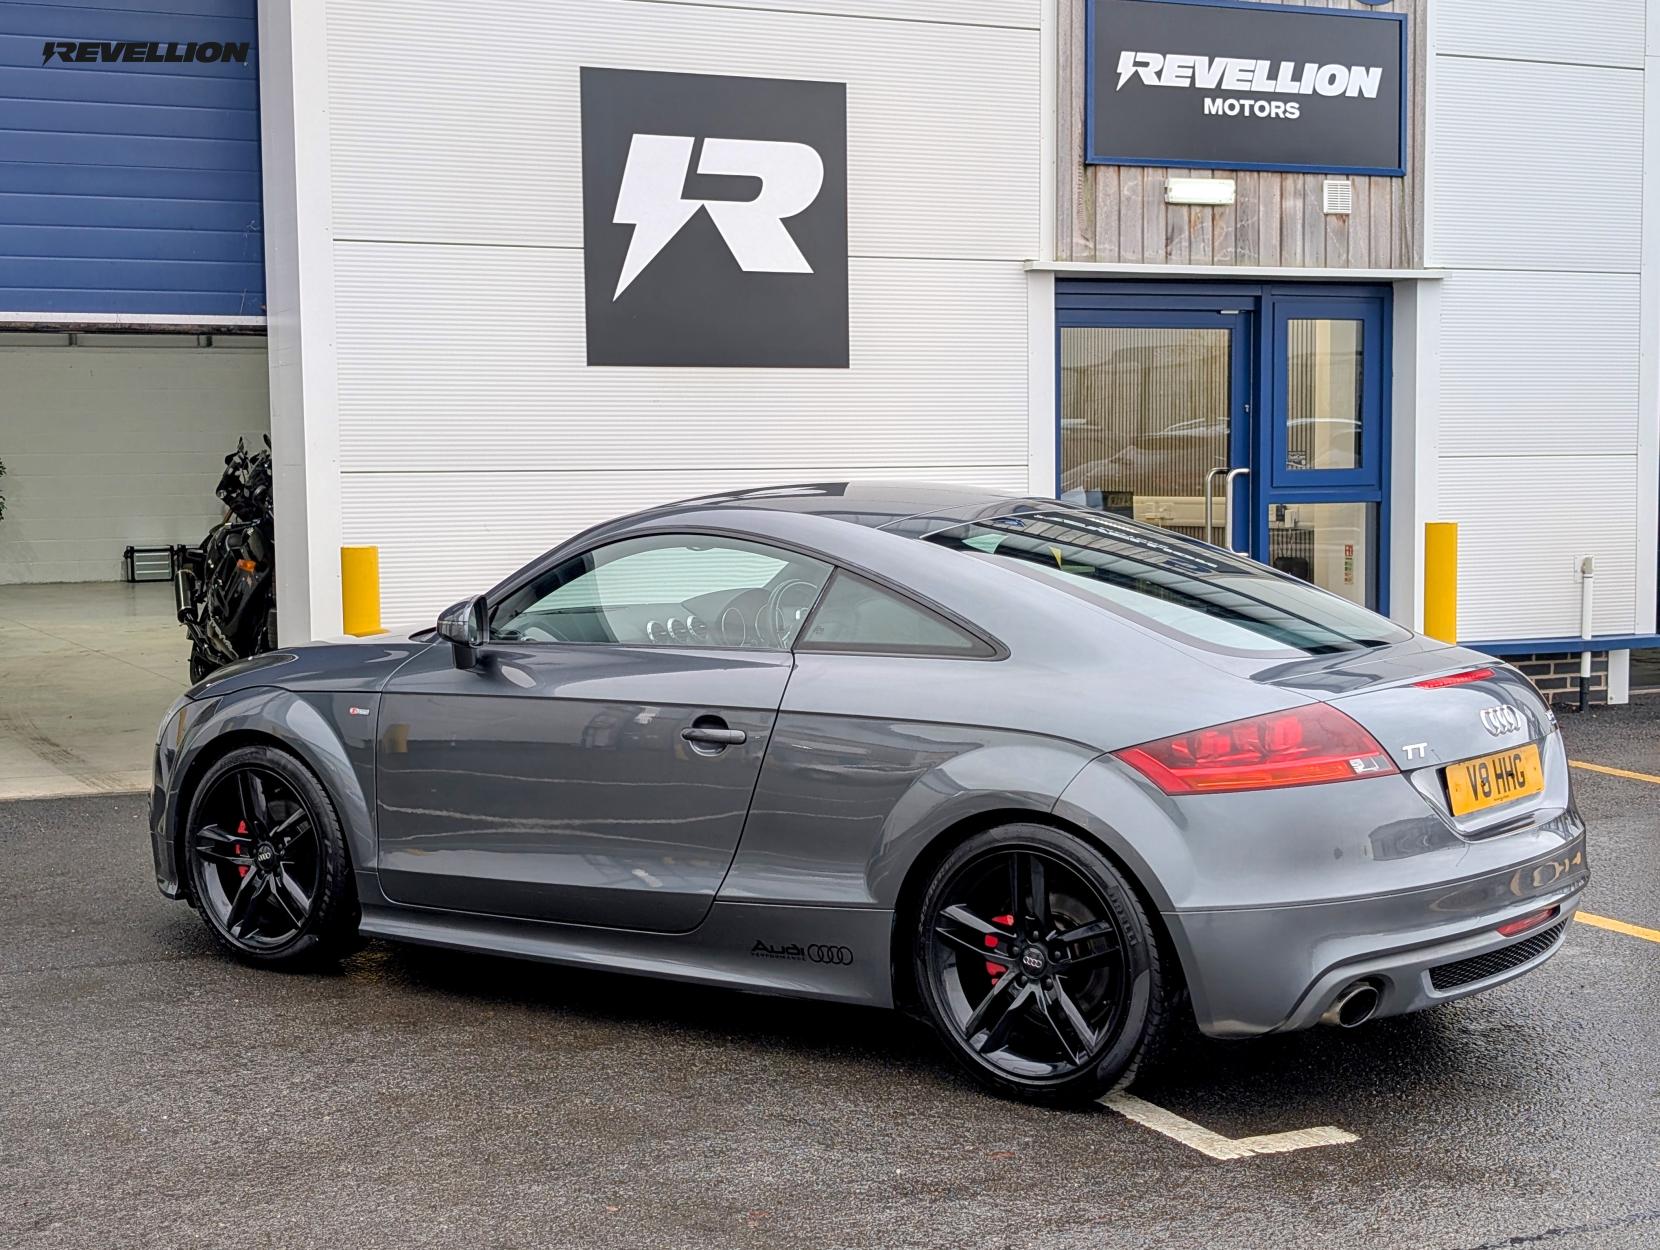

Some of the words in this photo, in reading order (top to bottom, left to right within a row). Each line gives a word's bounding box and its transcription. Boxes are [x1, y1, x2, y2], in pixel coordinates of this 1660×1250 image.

[1116, 50, 1383, 98] REVELLION
[1203, 97, 1300, 119] MOTORS
[1402, 742, 1428, 760] TT
[1466, 762, 1492, 801] V8
[1492, 753, 1526, 795] HHG
[752, 940, 805, 956] Audi
